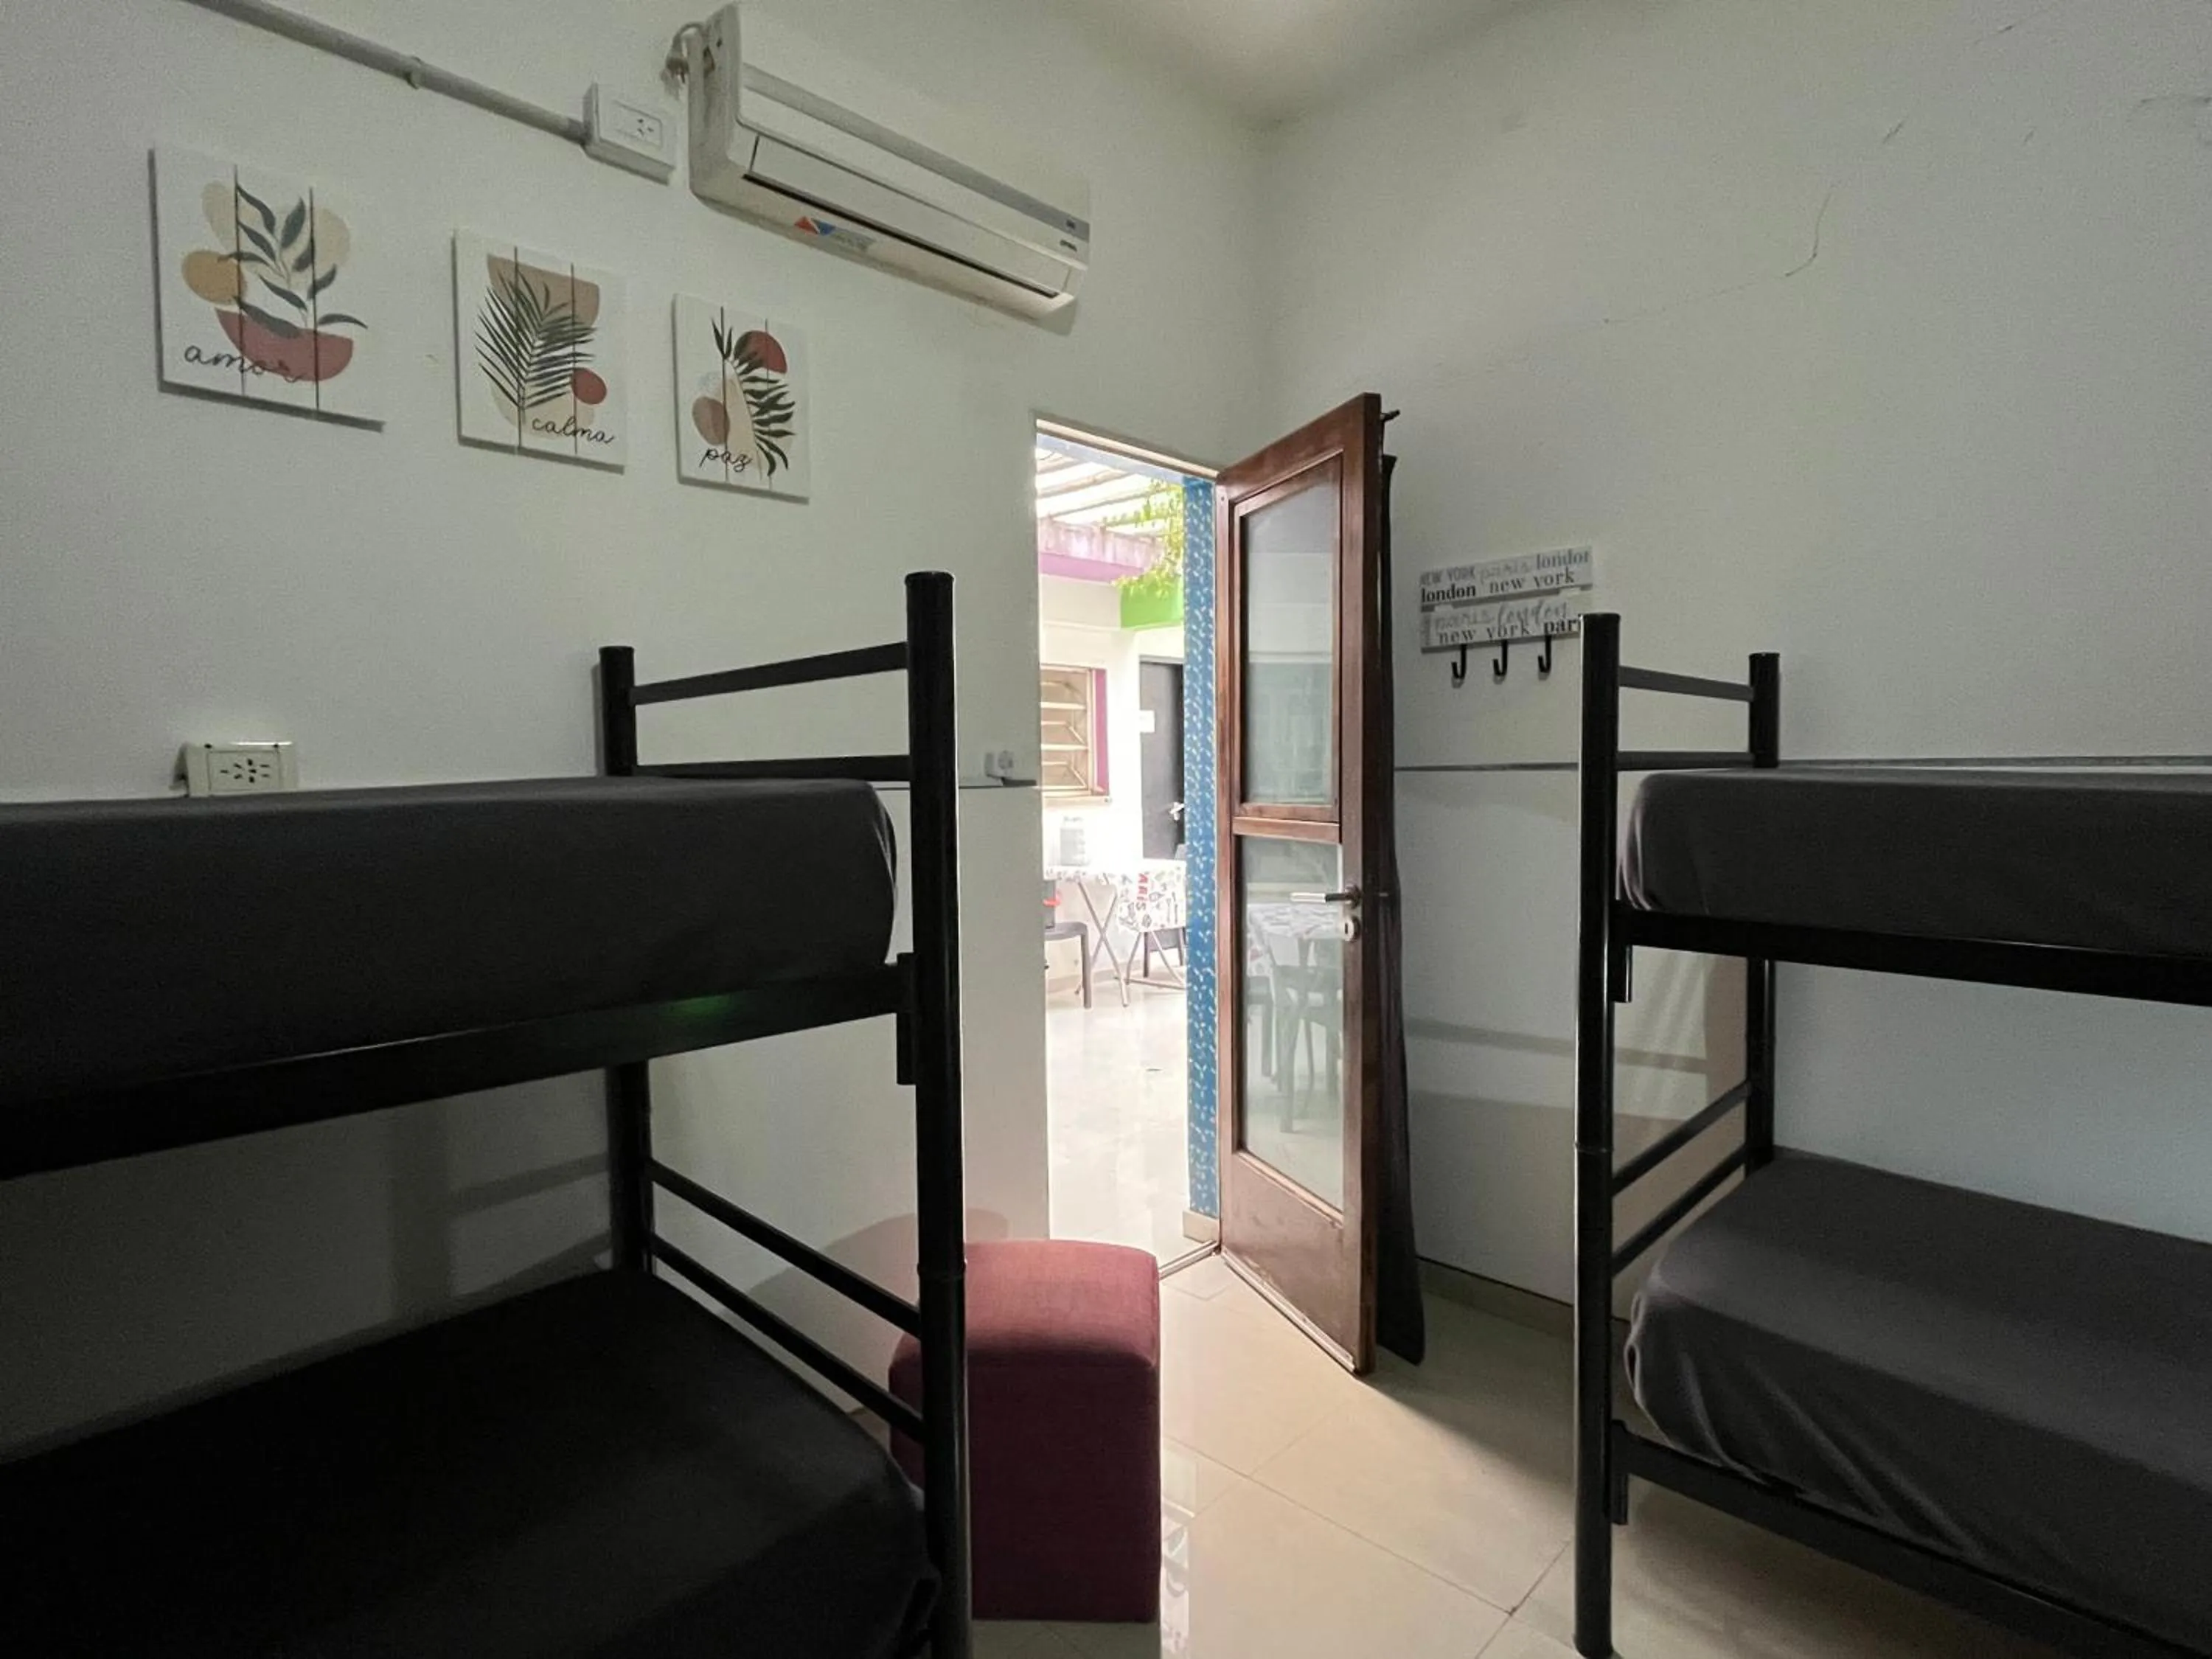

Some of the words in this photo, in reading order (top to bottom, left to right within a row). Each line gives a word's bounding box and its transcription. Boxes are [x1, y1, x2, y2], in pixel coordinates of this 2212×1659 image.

[532, 415, 614, 445] calma
[699, 448, 753, 473] paz
[1421, 583, 1477, 603] london
[1489, 577, 1526, 594] new
[1533, 566, 1575, 590] york
[1439, 629, 1477, 644] new
[1486, 620, 1531, 641] york
